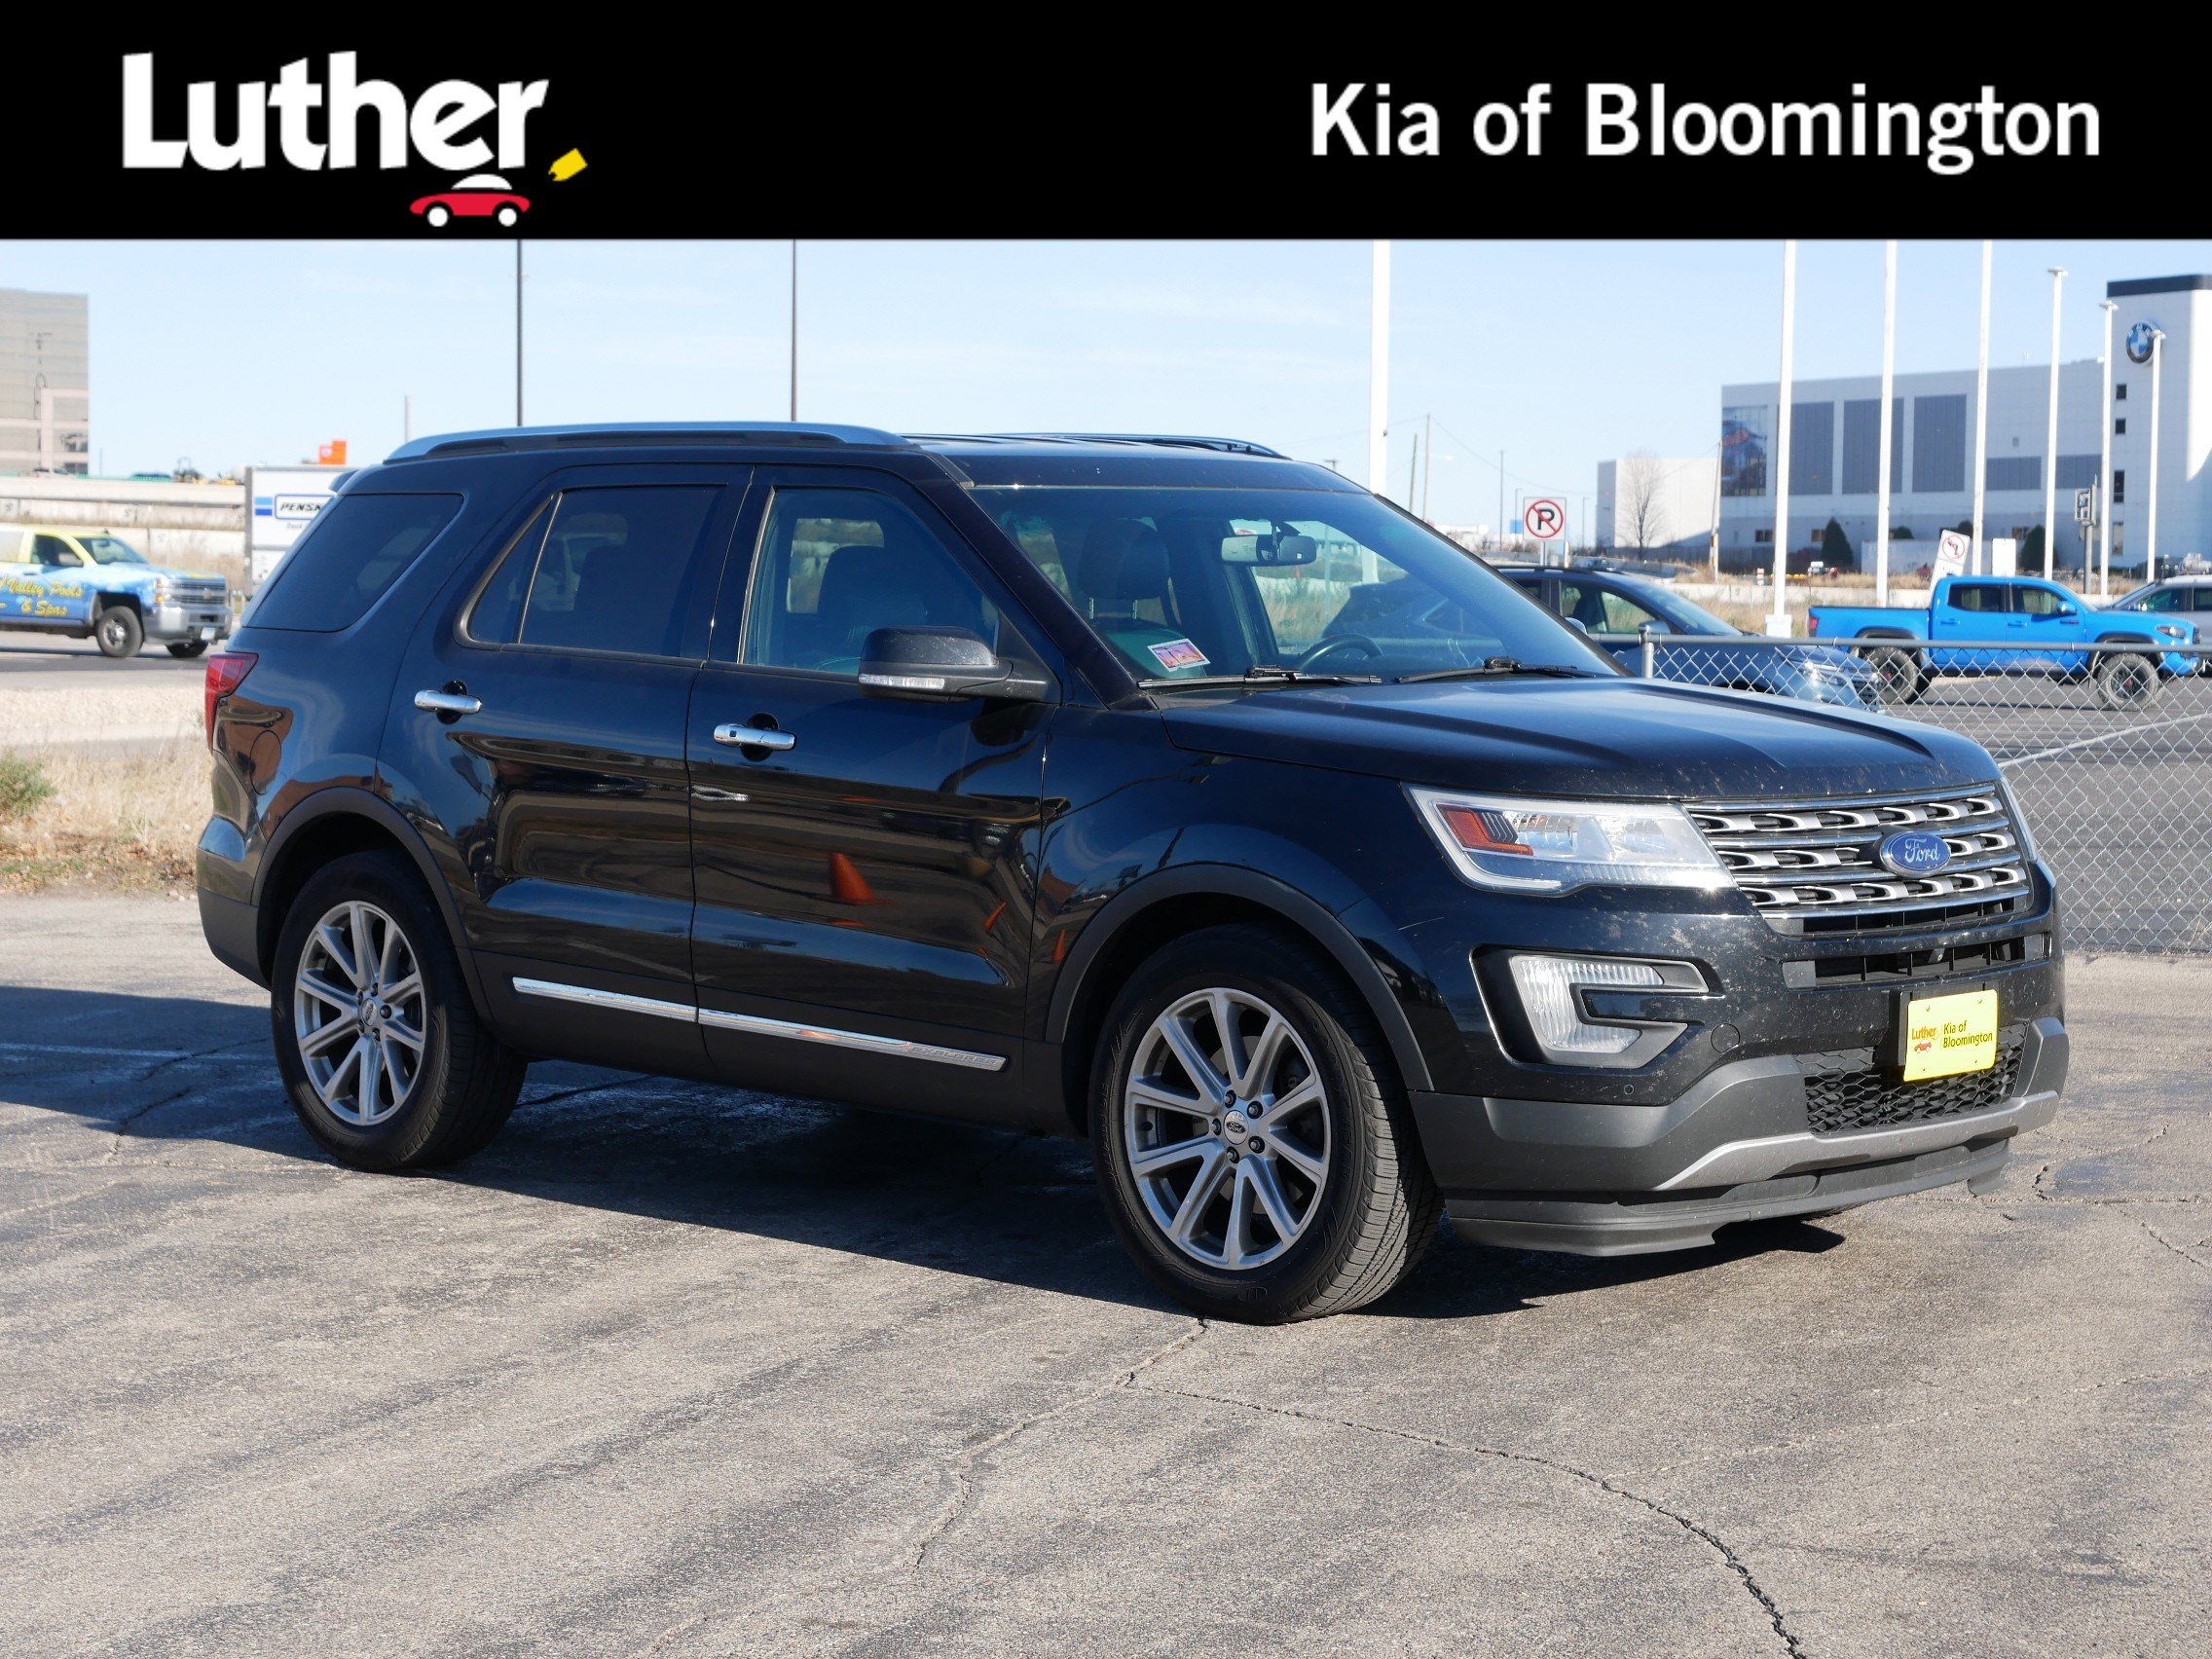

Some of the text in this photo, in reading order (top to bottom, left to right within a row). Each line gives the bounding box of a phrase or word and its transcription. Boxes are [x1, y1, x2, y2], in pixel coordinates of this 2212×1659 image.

[279, 502, 322, 512] PENSK
[1537, 509, 1555, 530] P
[7, 579, 45, 598] Valley
[50, 581, 83, 598] Pools
[21, 597, 67, 617] & Spas
[1904, 838, 1940, 863] Ford
[1911, 1026, 1937, 1041] Luther
[1943, 1020, 1968, 1035] Kia of
[1942, 1032, 1993, 1049] Bloomington
